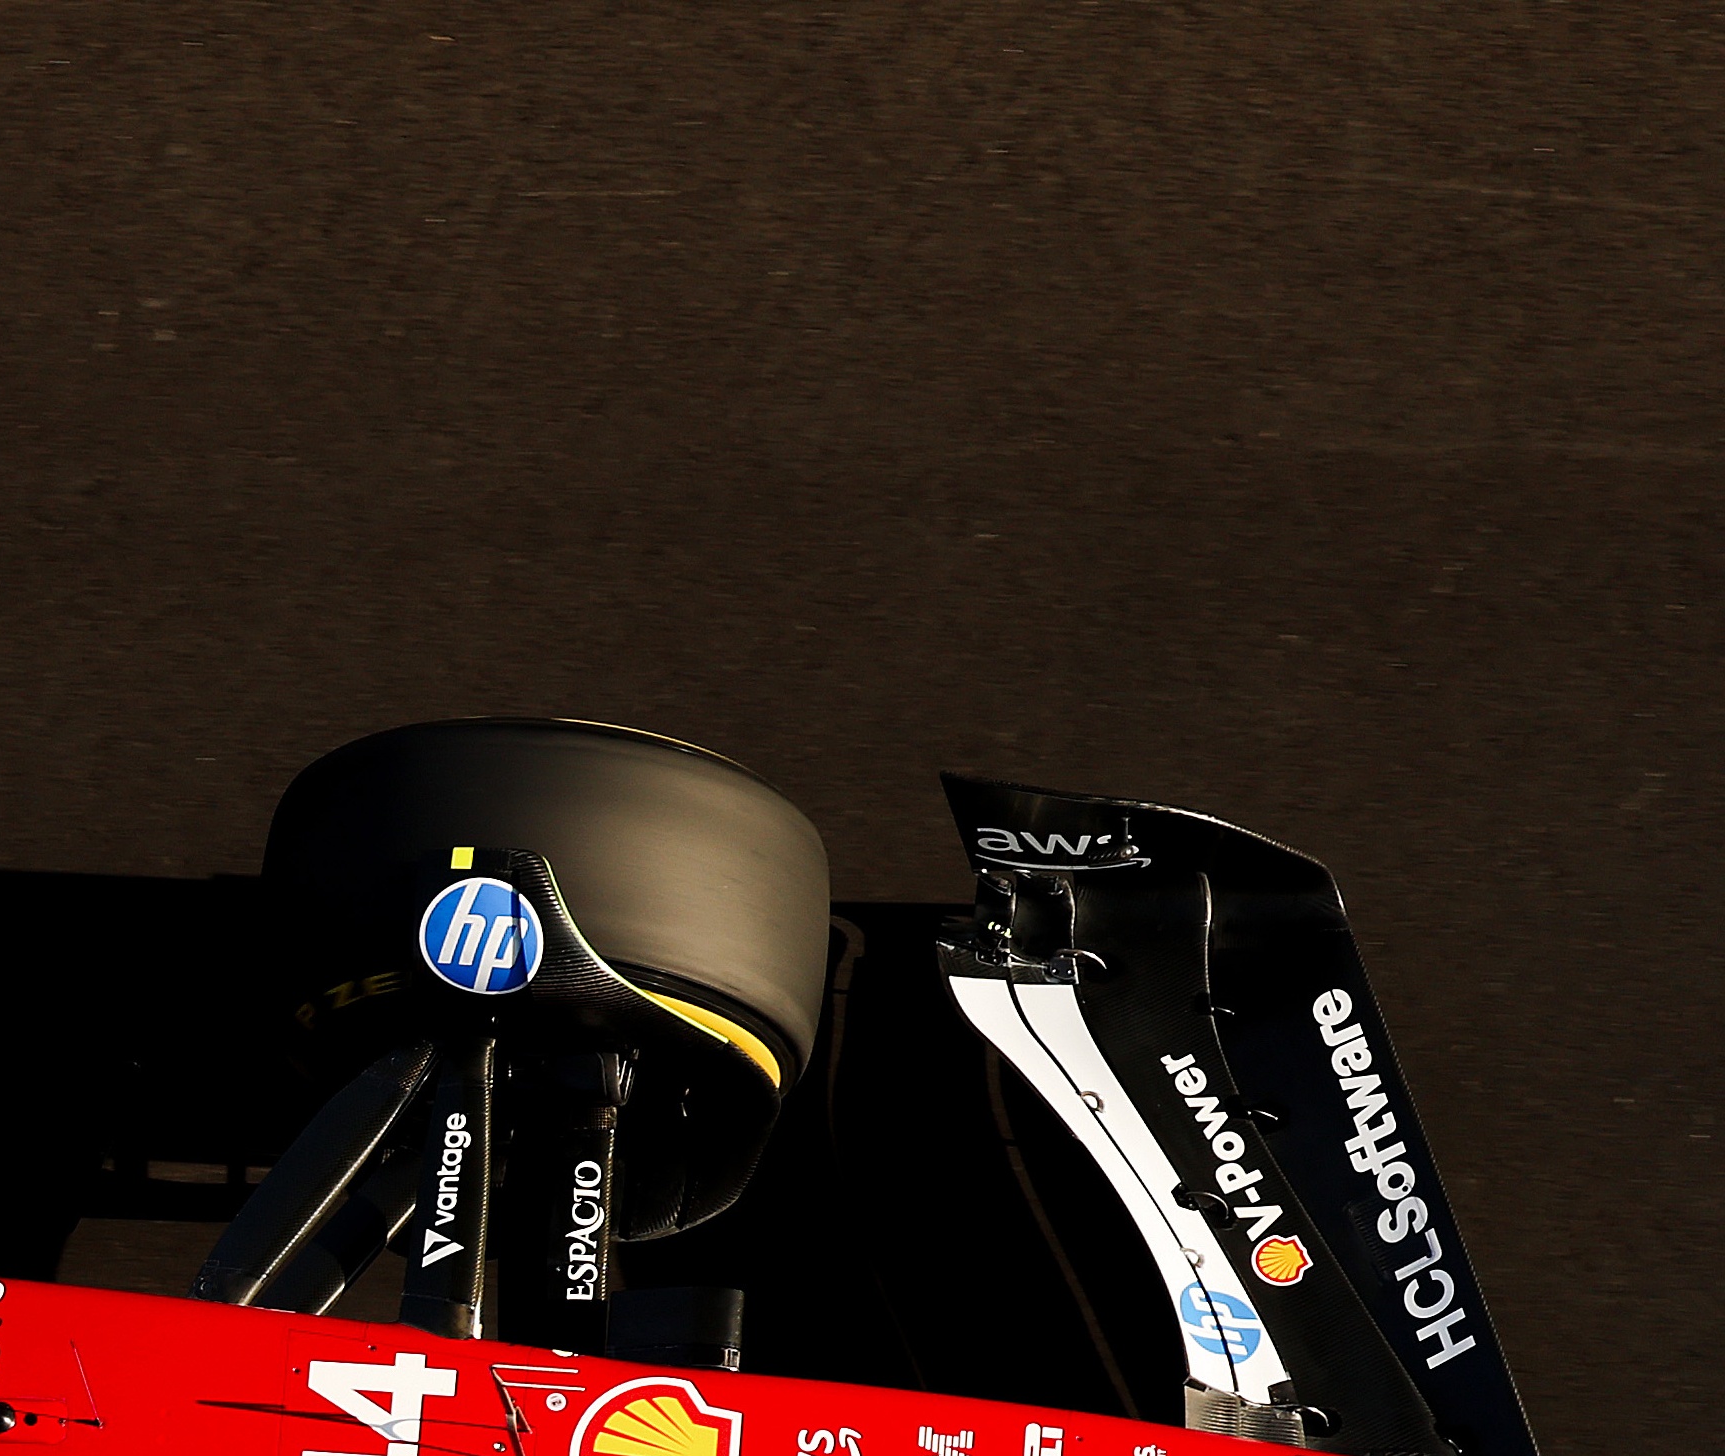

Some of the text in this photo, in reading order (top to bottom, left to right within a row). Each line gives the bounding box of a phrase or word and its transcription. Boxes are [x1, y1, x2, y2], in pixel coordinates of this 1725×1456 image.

[438, 878, 528, 993] hp
[434, 1112, 472, 1226] vantage
[1160, 1051, 1284, 1242] V-Power
[565, 1160, 603, 1301] ESPACIO
